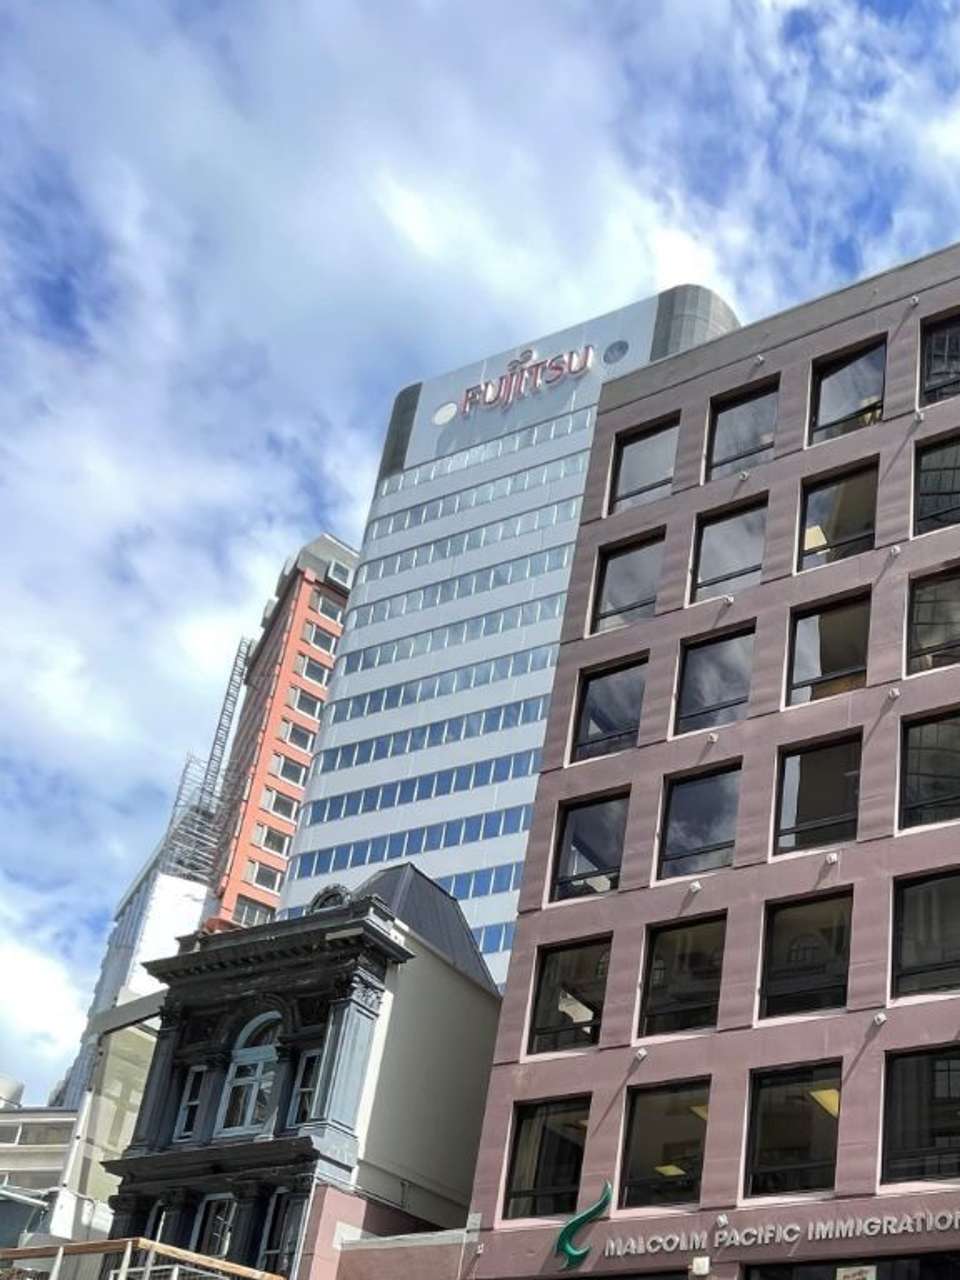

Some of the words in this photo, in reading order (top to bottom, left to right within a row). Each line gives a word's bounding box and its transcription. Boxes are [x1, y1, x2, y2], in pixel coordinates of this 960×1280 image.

[460, 344, 595, 417] FUJITSU
[604, 1232, 708, 1258] MALCOLM
[714, 1222, 801, 1248] PACIFIC
